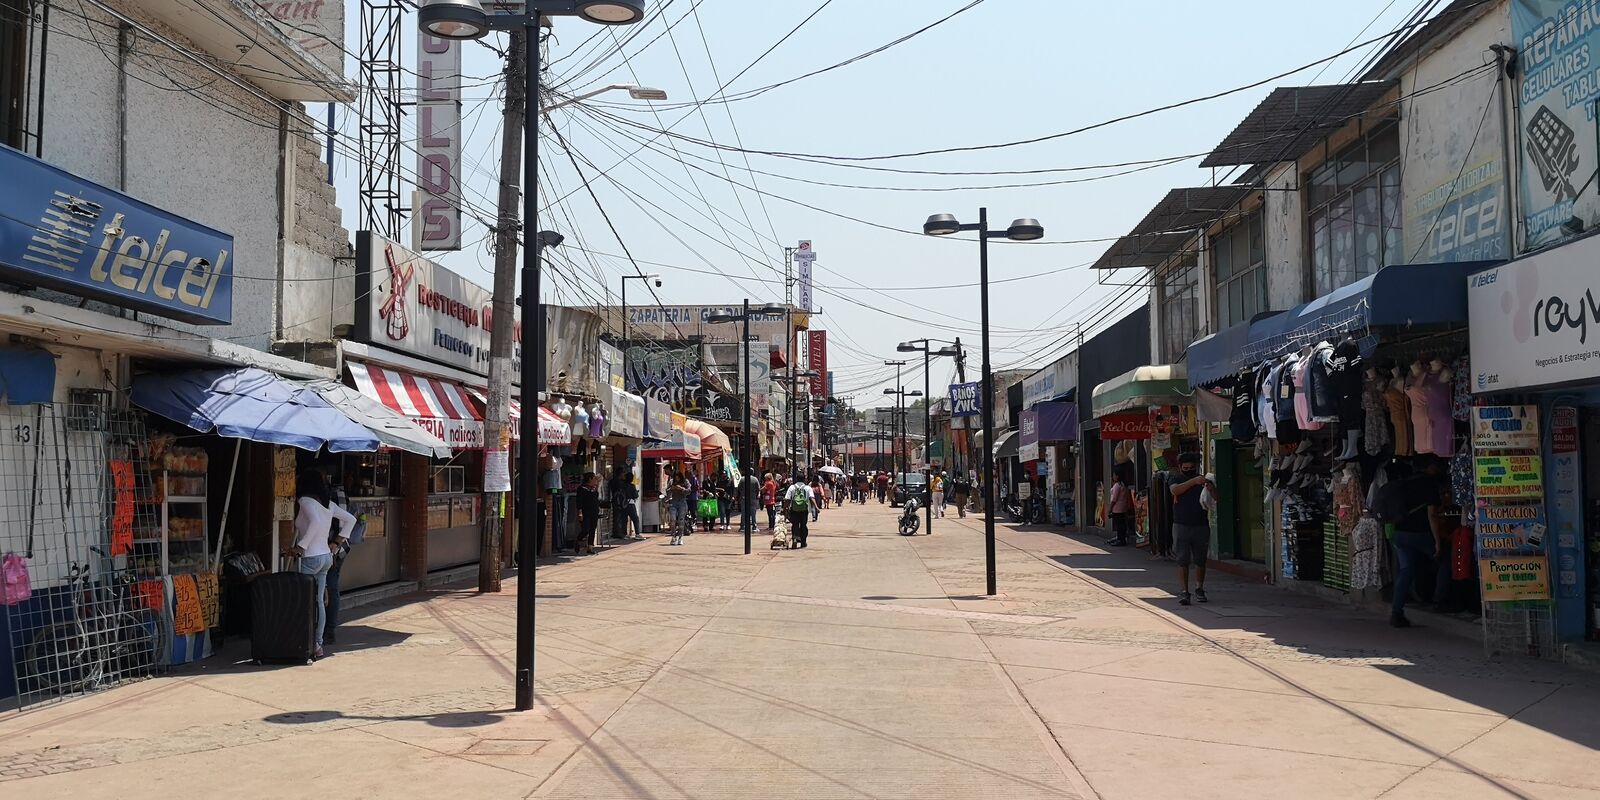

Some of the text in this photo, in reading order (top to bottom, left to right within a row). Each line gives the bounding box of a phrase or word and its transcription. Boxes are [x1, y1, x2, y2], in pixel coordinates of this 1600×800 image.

[1522, 44, 1590, 103] CELULARES
[1430, 185, 1504, 257] telcel
[1526, 200, 1573, 236] SOFTWARE
[90, 212, 229, 309] telcel
[1477, 270, 1498, 287] telcel
[418, 284, 479, 328] ROSTICERIA
[629, 308, 690, 322] ZAPATERIA
[1536, 357, 1558, 368] Negocios
[1559, 355, 1564, 363] &
[1565, 351, 1591, 361] Estrategia
[952, 386, 976, 401] BAÑOS
[1520, 406, 1527, 418] A
[15, 424, 30, 442] 13
[1103, 421, 1124, 432] Red
